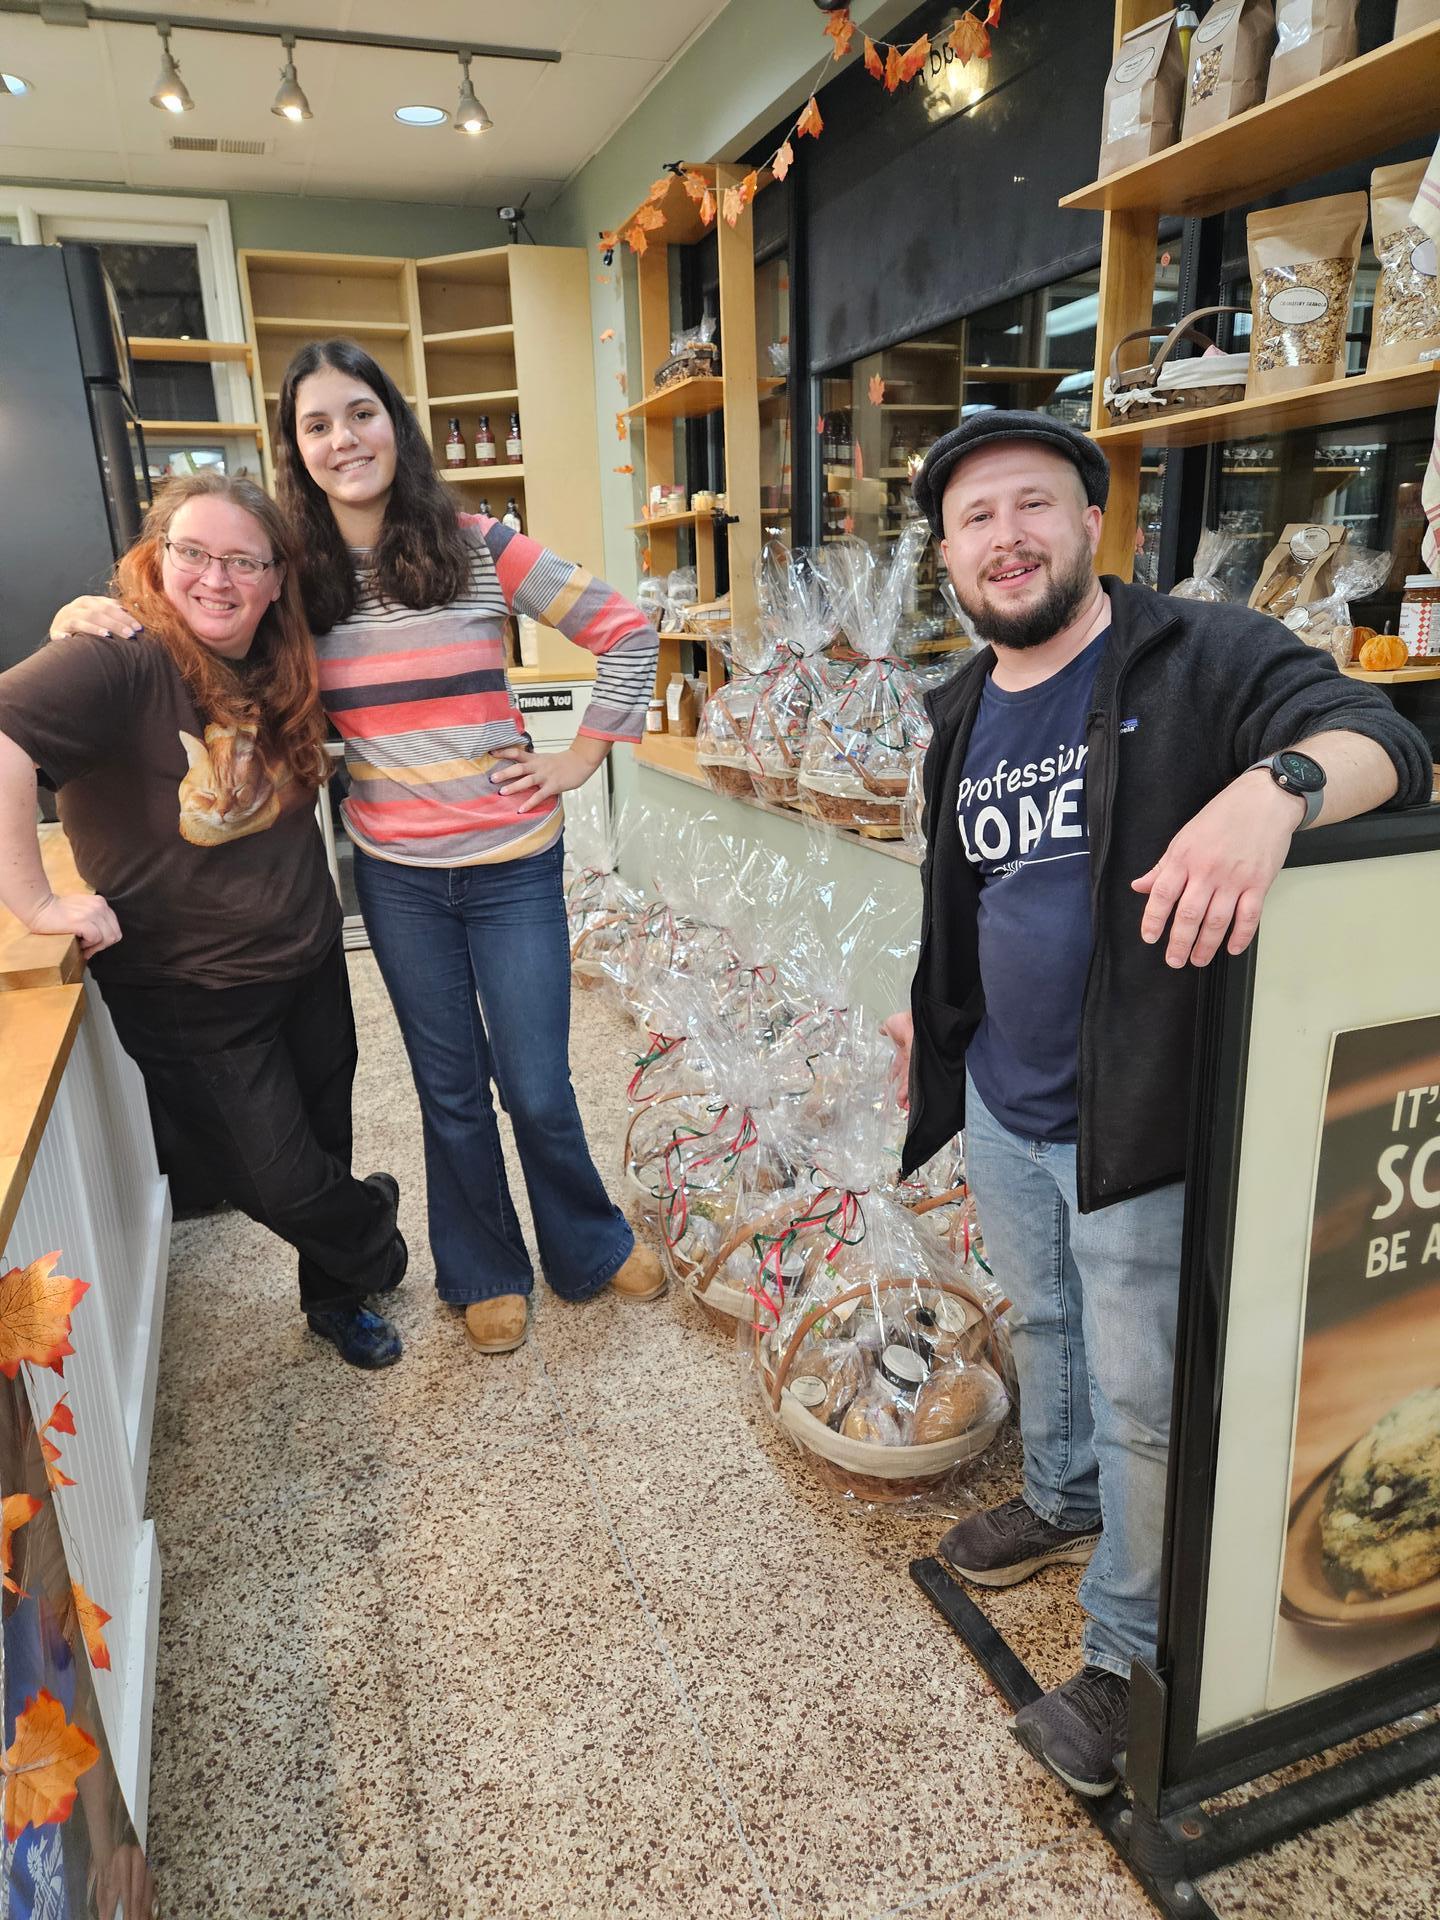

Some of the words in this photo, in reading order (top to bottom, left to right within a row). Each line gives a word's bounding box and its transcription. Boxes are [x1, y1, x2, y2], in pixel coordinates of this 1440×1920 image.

[519, 696, 550, 709] THANK
[552, 695, 572, 707] YOU
[1392, 1085, 1440, 1132] IT'
[1365, 1230, 1411, 1279] BE
